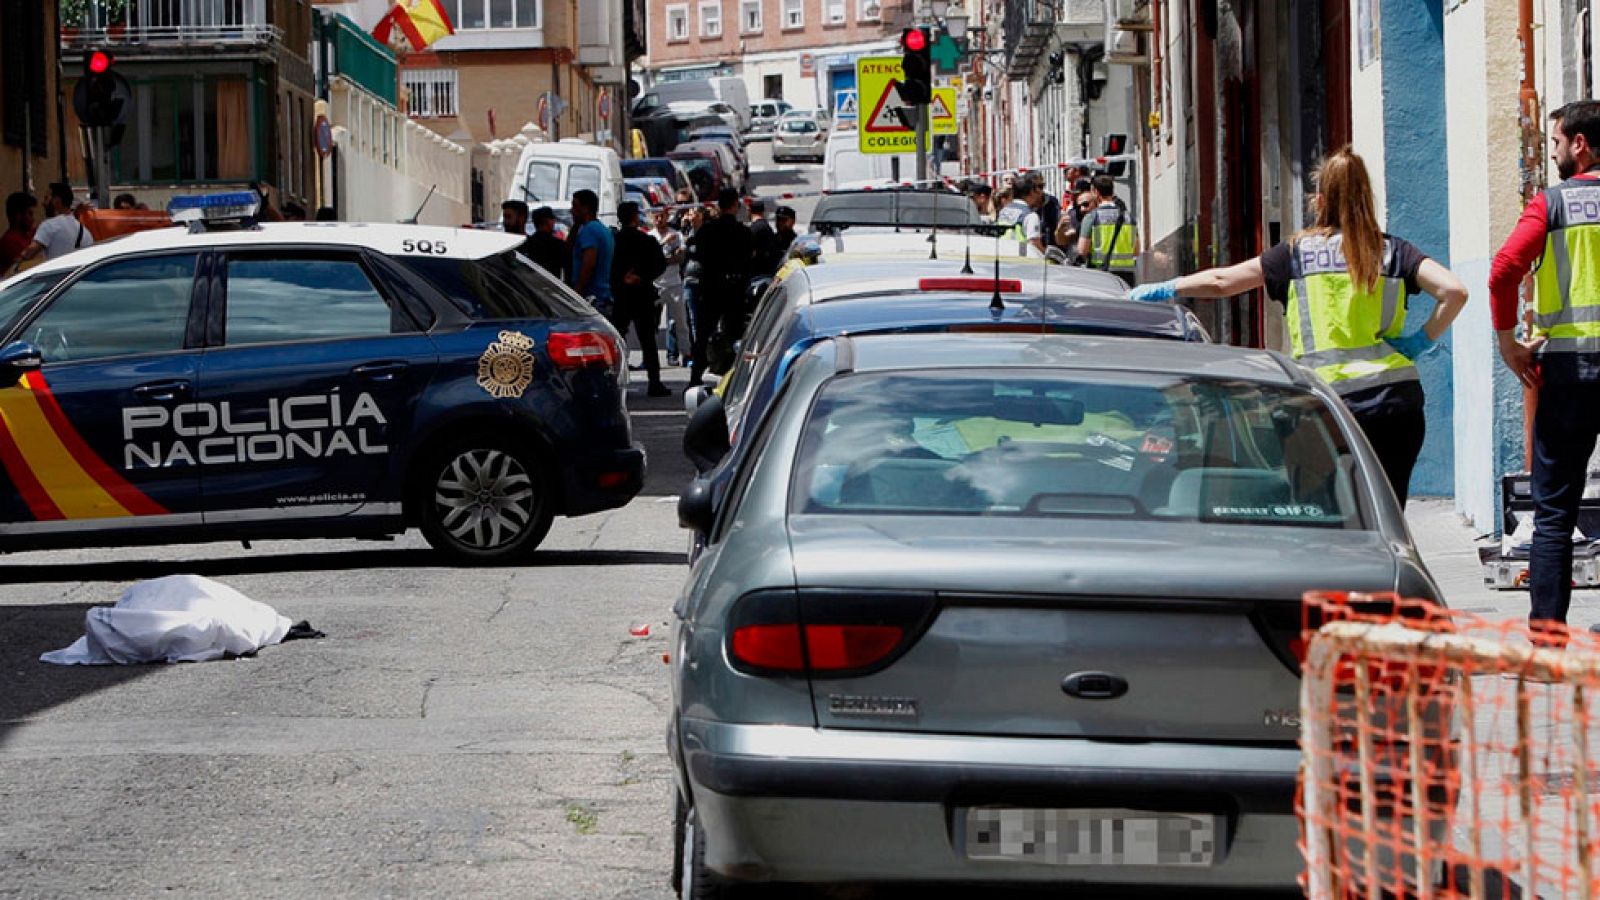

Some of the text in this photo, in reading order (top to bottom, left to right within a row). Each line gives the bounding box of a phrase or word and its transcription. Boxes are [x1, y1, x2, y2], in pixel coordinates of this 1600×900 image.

[862, 63, 903, 74] ATENC
[402, 239, 447, 254] 5Q5
[122, 386, 387, 441] POLICÍA
[123, 427, 388, 470] NACIONAL
